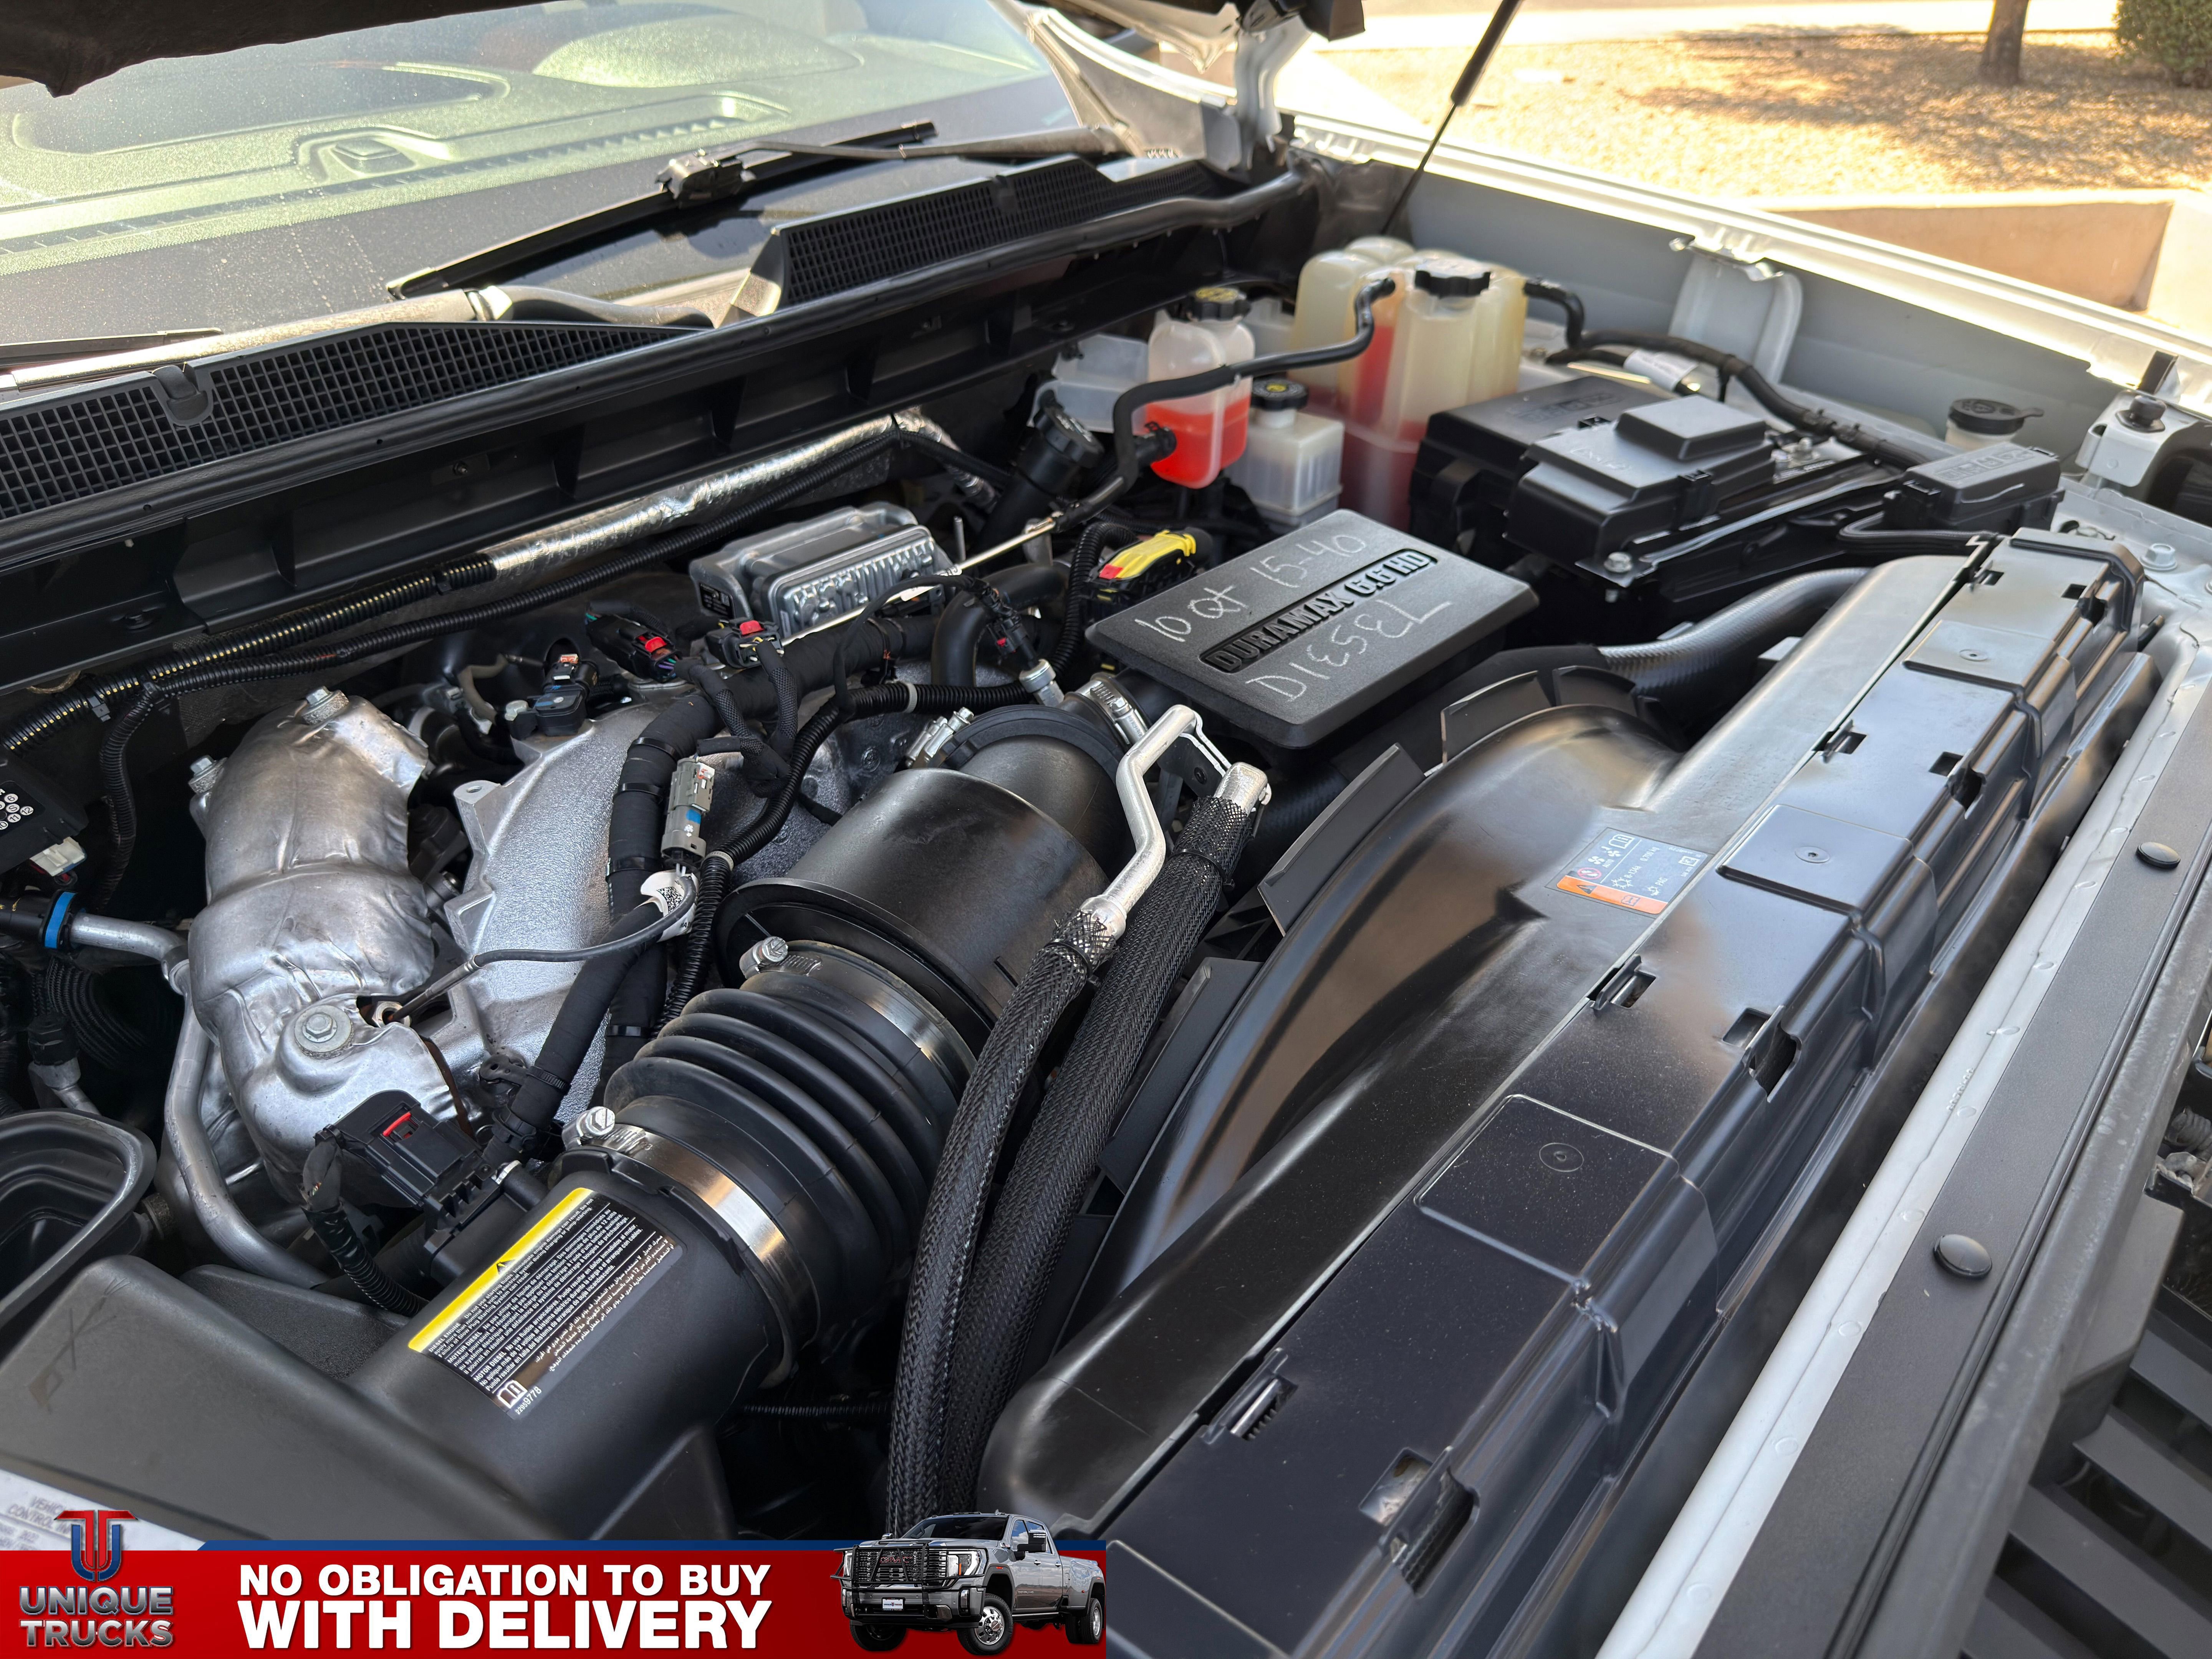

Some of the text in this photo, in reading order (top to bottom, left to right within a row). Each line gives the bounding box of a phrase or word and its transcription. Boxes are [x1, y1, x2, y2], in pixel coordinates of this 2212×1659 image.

[1135, 616, 1191, 643] 10
[1249, 535, 1367, 588] 15-40
[1205, 551, 1432, 671] DURAMAX 6.6 HD
[1245, 599, 1454, 702] DIESEL
[428, 1338, 445, 1352] DIESEL
[444, 1322, 461, 1338] ENGINE
[485, 1284, 502, 1299] starting
[533, 1242, 547, 1254] engine
[546, 1227, 562, 1242] damage
[434, 1343, 447, 1355] apply
[445, 1333, 457, 1344] more
[456, 1324, 467, 1333] than
[465, 1309, 483, 1325] nominal
[487, 1295, 498, 1304] volts
[501, 1274, 520, 1291] electrical
[518, 1261, 534, 1275] system
[532, 1249, 547, 1262] during
[545, 1234, 563, 1250] charging
[438, 1343, 454, 1358] Failure
[457, 1328, 470, 1339] Glow
[468, 1319, 480, 1330] Plug
[478, 1304, 496, 1320] Starting
[493, 1290, 510, 1305] System
[447, 1345, 467, 1363] MOTEUR
[465, 1331, 483, 1346] DIESEL
[490, 1316, 499, 1324] pas
[497, 1302, 512, 1316] utiliser
[516, 1284, 532, 1298] liquide
[556, 1251, 566, 1259] Des
[565, 1232, 587, 1252] dommages
[453, 1351, 470, 1367] moteur
[468, 1331, 491, 1353] pourraient
[518, 1297, 527, 1305] pas
[525, 1280, 545, 1298] appliquer
[550, 1258, 567, 1273] tension
[565, 1242, 584, 1260] nominale
[587, 1230, 598, 1238] plus
[606, 1211, 617, 1220] volts
[467, 1354, 485, 1371] pourrait
[504, 1328, 513, 1336] une
[582, 1245, 600, 1260] bougies
[473, 1365, 492, 1382] MOTOR
[489, 1351, 507, 1366] DIESEL
[512, 1336, 522, 1345] use
[518, 1324, 534, 1338] fluidos
[532, 1300, 560, 1325] arrancadores.
[557, 1287, 572, 1300] Puede
[570, 1273, 586, 1288] resultar
[599, 1238, 622, 1258] inmediatos
[623, 1224, 637, 1236] motor.
[486, 1365, 503, 1381] aplique
[520, 1333, 535, 1346] voltios
[537, 1313, 555, 1330] sistema
[569, 1283, 586, 1298] durante
[588, 1269, 601, 1281] carga
[605, 1247, 624, 1264] arranque
[621, 1240, 631, 1248] con
[628, 1228, 643, 1241] cables.
[502, 1312, 520, 1329] pendant
[522, 1295, 538, 1309] charge
[569, 1252, 582, 1263] l'aide
[580, 1242, 593, 1253] d'une
[590, 1229, 606, 1243] batterie
[604, 1214, 623, 1230] auxiliaire.
[485, 1377, 500, 1391] Puede
[498, 1362, 516, 1378] resultar
[519, 1348, 530, 1358] falla
[528, 1341, 537, 1349] del
[534, 1326, 553, 1343] Sistema
[556, 1305, 575, 1322] arranque
[514, 1386, 542, 1414] 22959778
